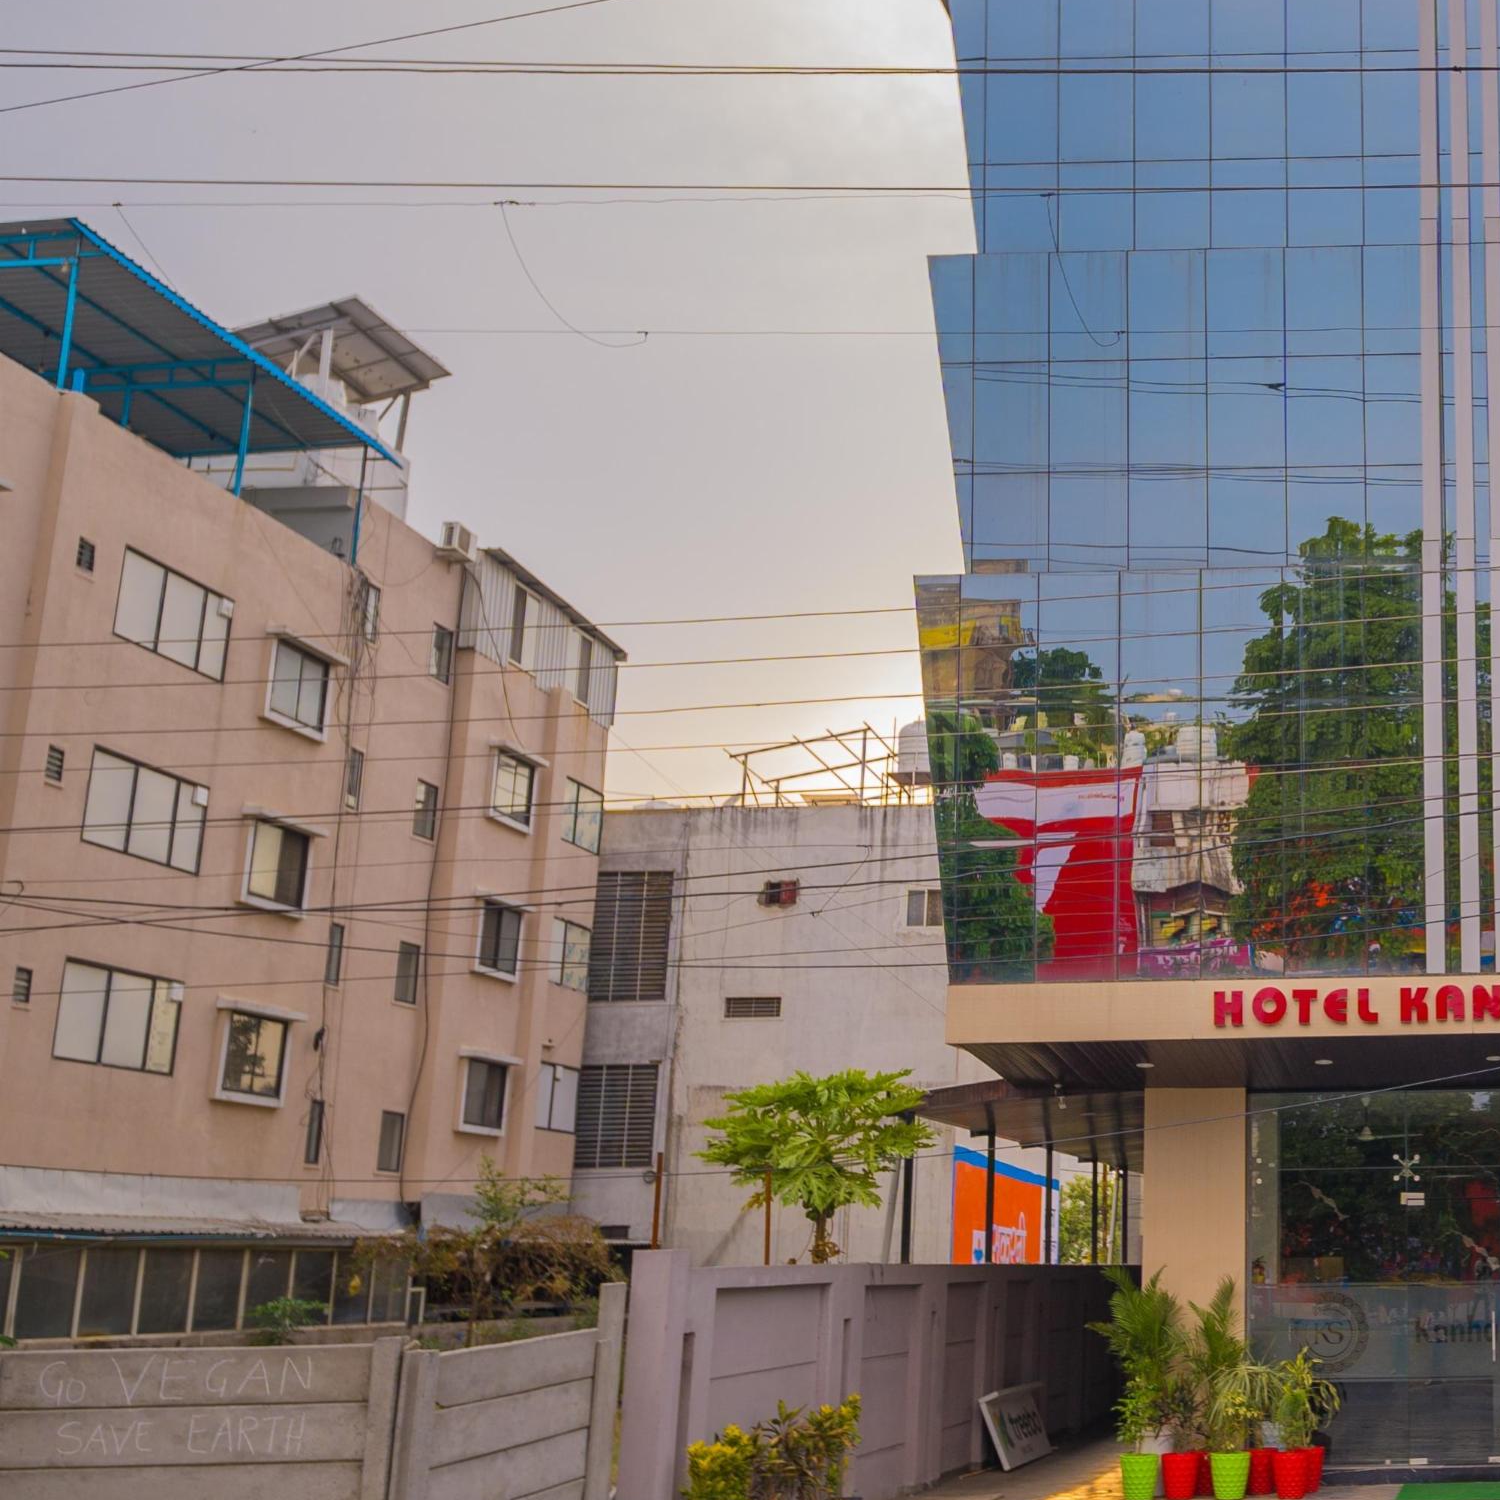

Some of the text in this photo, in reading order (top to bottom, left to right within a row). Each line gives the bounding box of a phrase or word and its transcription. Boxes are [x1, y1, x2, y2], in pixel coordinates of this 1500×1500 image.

[1213, 987, 1379, 1027] HOTEL
[112, 1354, 312, 1406] VEGAN
[56, 1413, 306, 1457] SAVE EARTH
